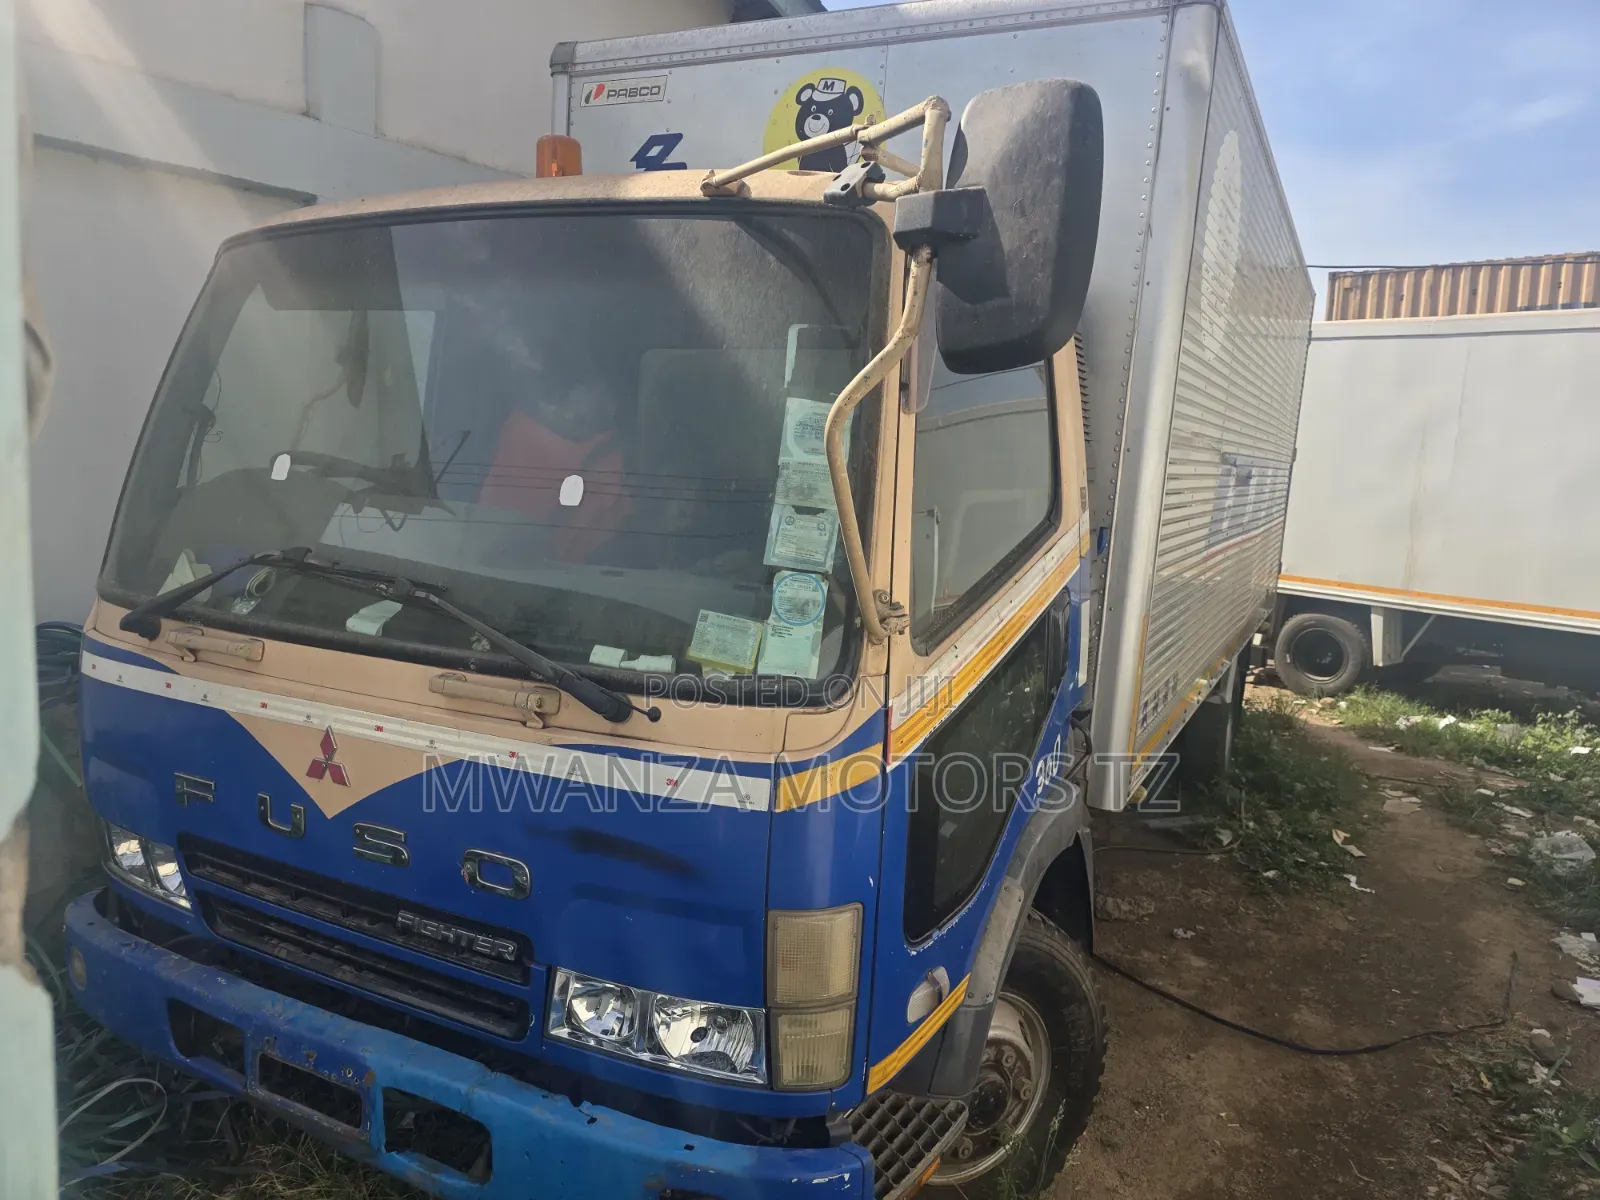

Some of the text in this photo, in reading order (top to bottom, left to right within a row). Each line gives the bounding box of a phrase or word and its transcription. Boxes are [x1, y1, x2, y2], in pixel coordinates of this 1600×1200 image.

[606, 85, 661, 100] PABCO
[822, 80, 836, 92] M
[174, 771, 532, 900] FUSO
[396, 909, 519, 962] FIGHTER
